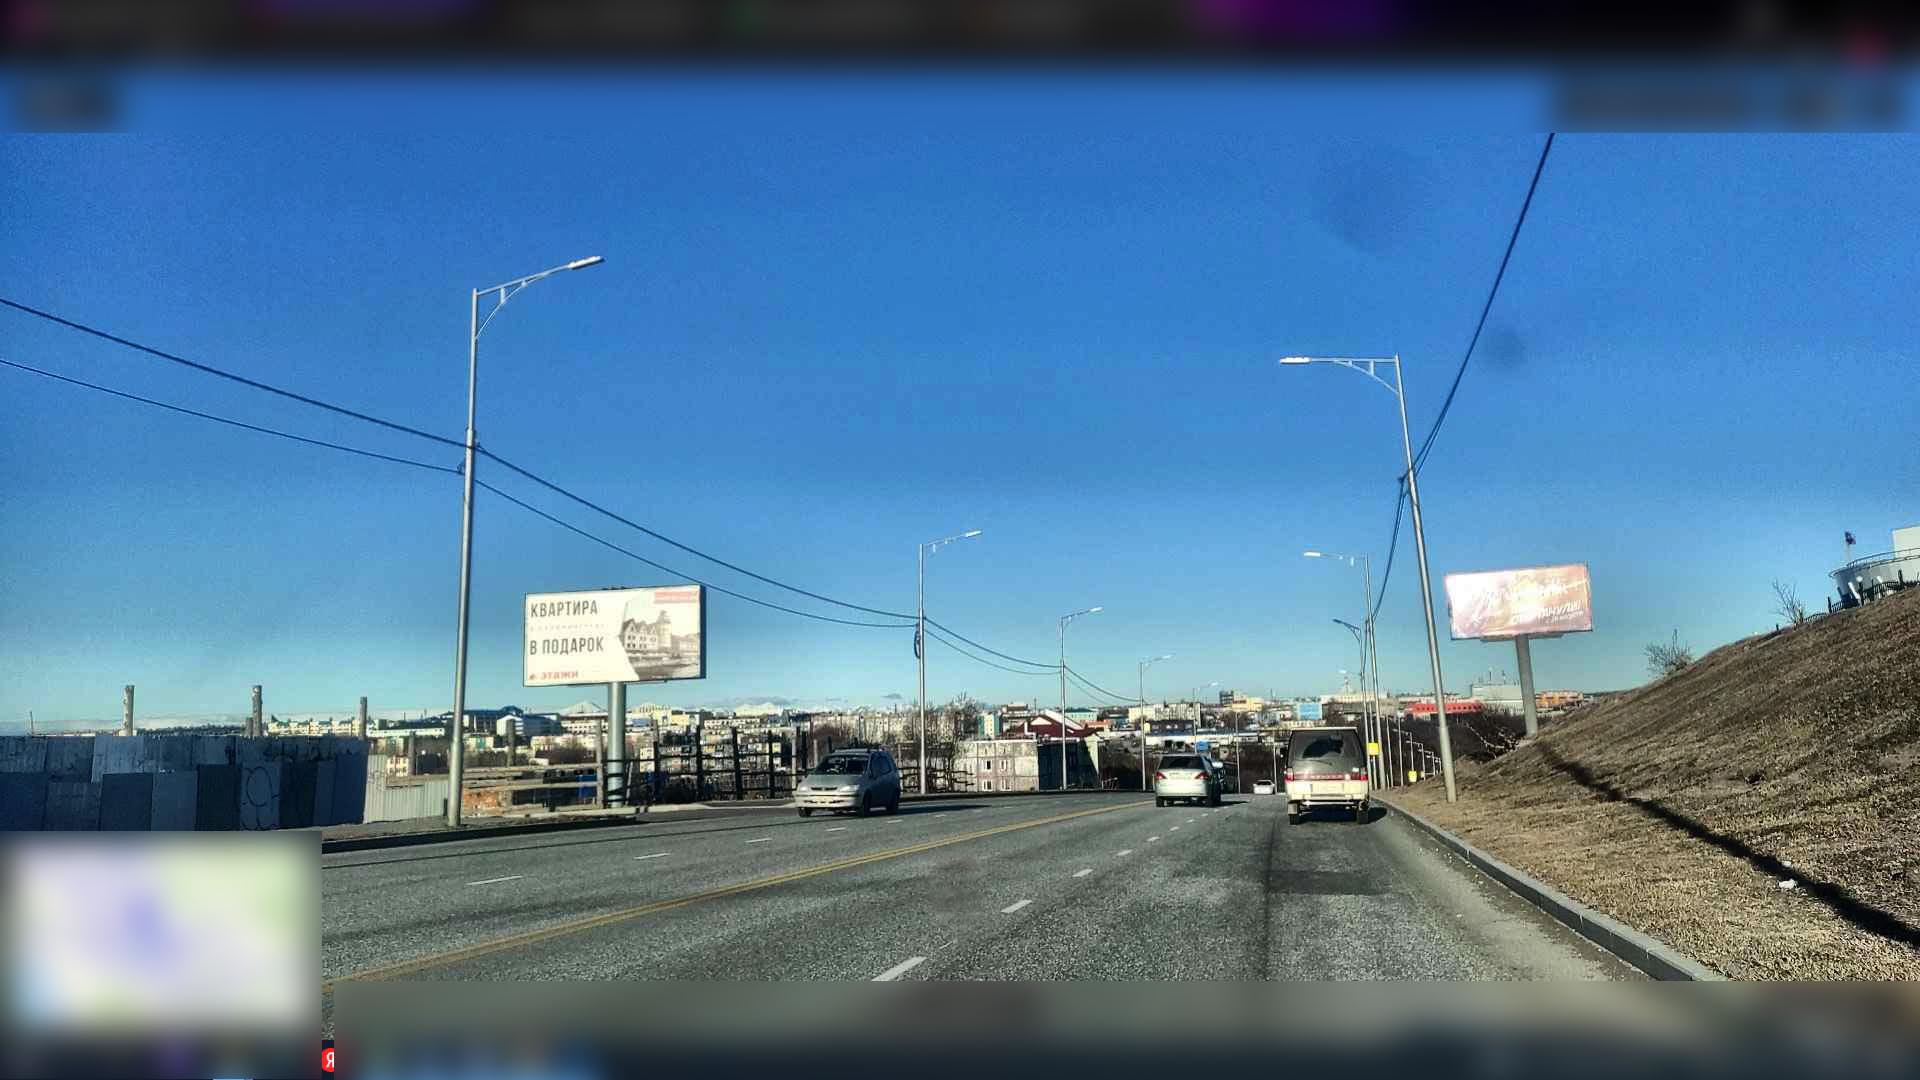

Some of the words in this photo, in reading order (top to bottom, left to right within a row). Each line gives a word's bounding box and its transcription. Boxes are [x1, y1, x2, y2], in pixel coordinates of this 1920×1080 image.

[530, 599, 598, 618] КВАРТИРА
[529, 639, 537, 656] В
[542, 637, 604, 655] ПОДАРОК
